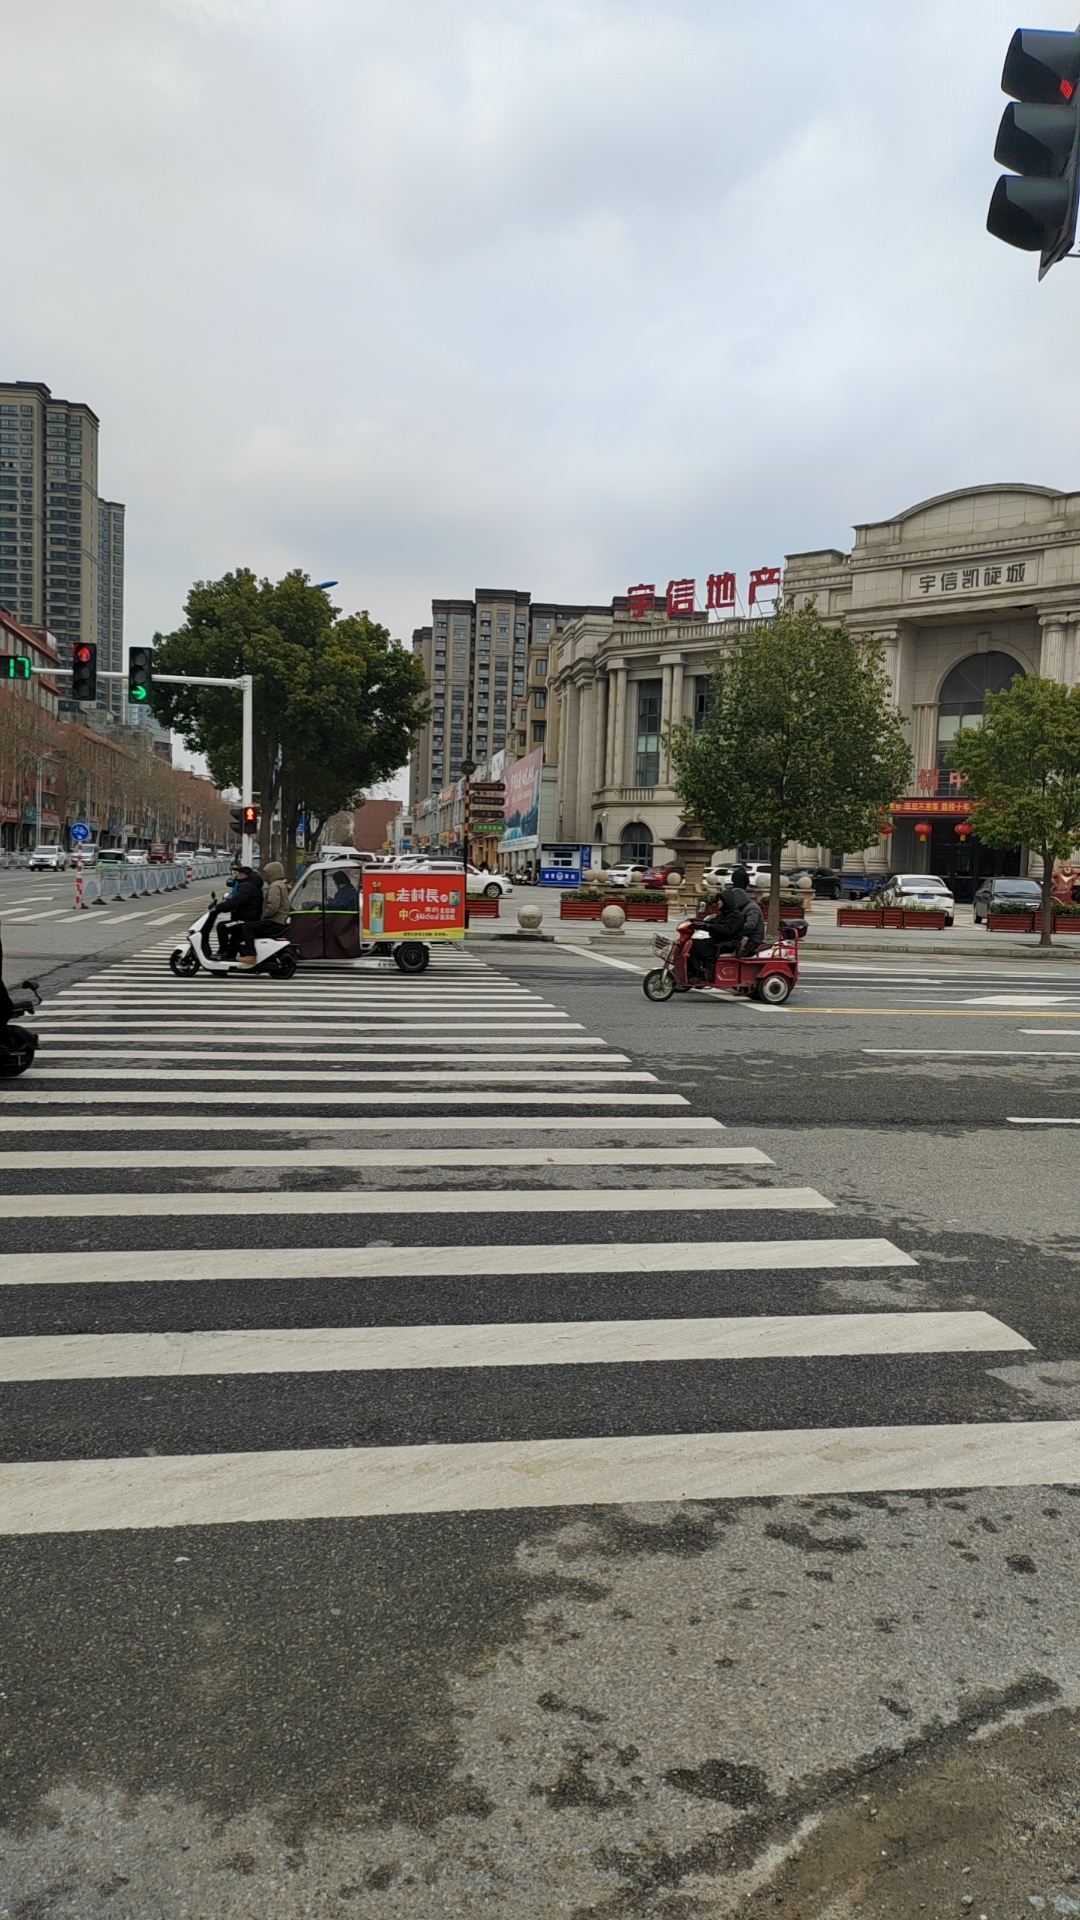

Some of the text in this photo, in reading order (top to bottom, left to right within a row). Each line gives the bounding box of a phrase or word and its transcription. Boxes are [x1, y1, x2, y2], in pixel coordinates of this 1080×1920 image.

[626, 567, 781, 618] 宇信地产
[918, 562, 1026, 594] 宇信凯旋城
[9, 657, 30, 678] 17
